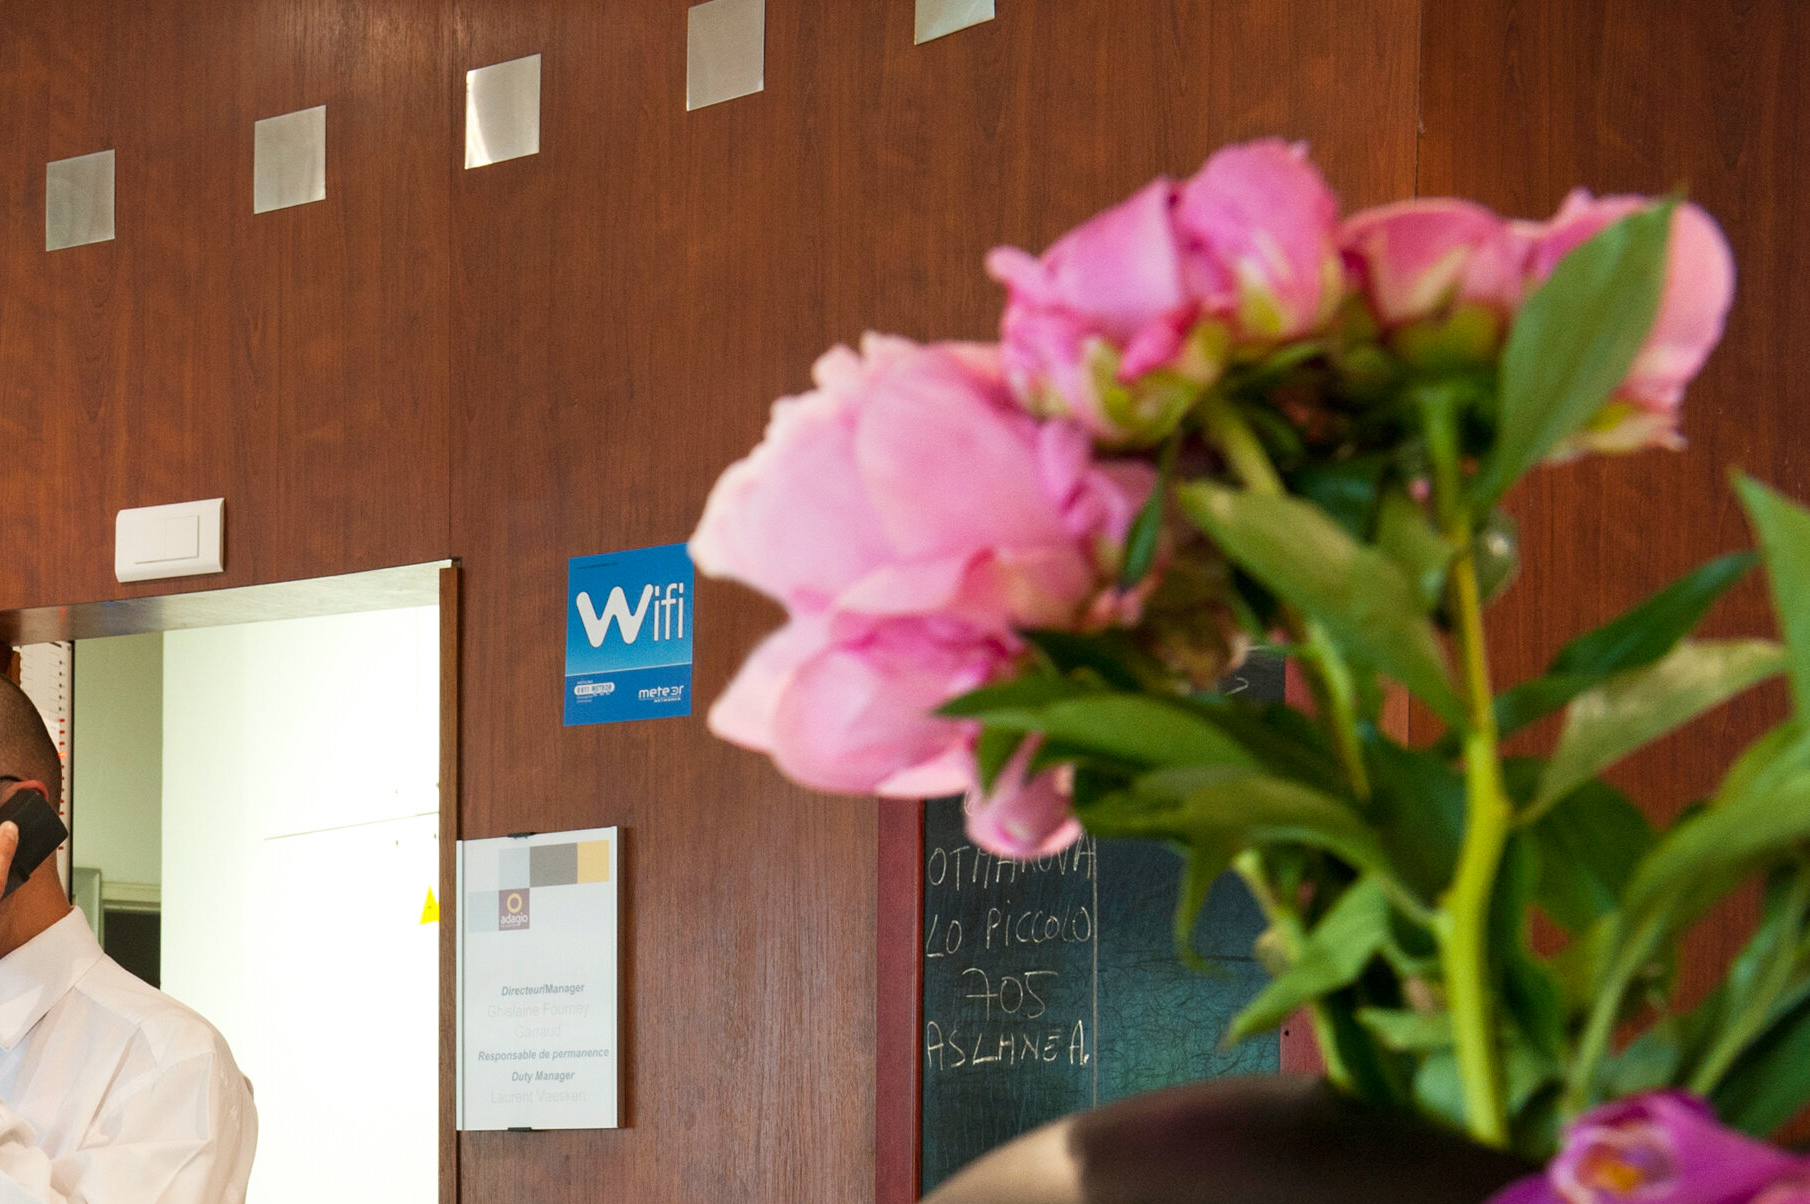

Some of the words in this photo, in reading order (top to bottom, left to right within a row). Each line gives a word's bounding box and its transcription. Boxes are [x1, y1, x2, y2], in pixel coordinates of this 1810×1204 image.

[576, 583, 684, 648] Wifi
[500, 912, 528, 926] adagio
[926, 914, 962, 957] LO
[961, 968, 1059, 1021] 705
[478, 1050, 536, 1062] Responsable
[539, 1049, 550, 1059] de
[552, 1048, 609, 1061] permanence
[511, 1071, 533, 1083] Duty
[535, 1071, 575, 1082] Manager
